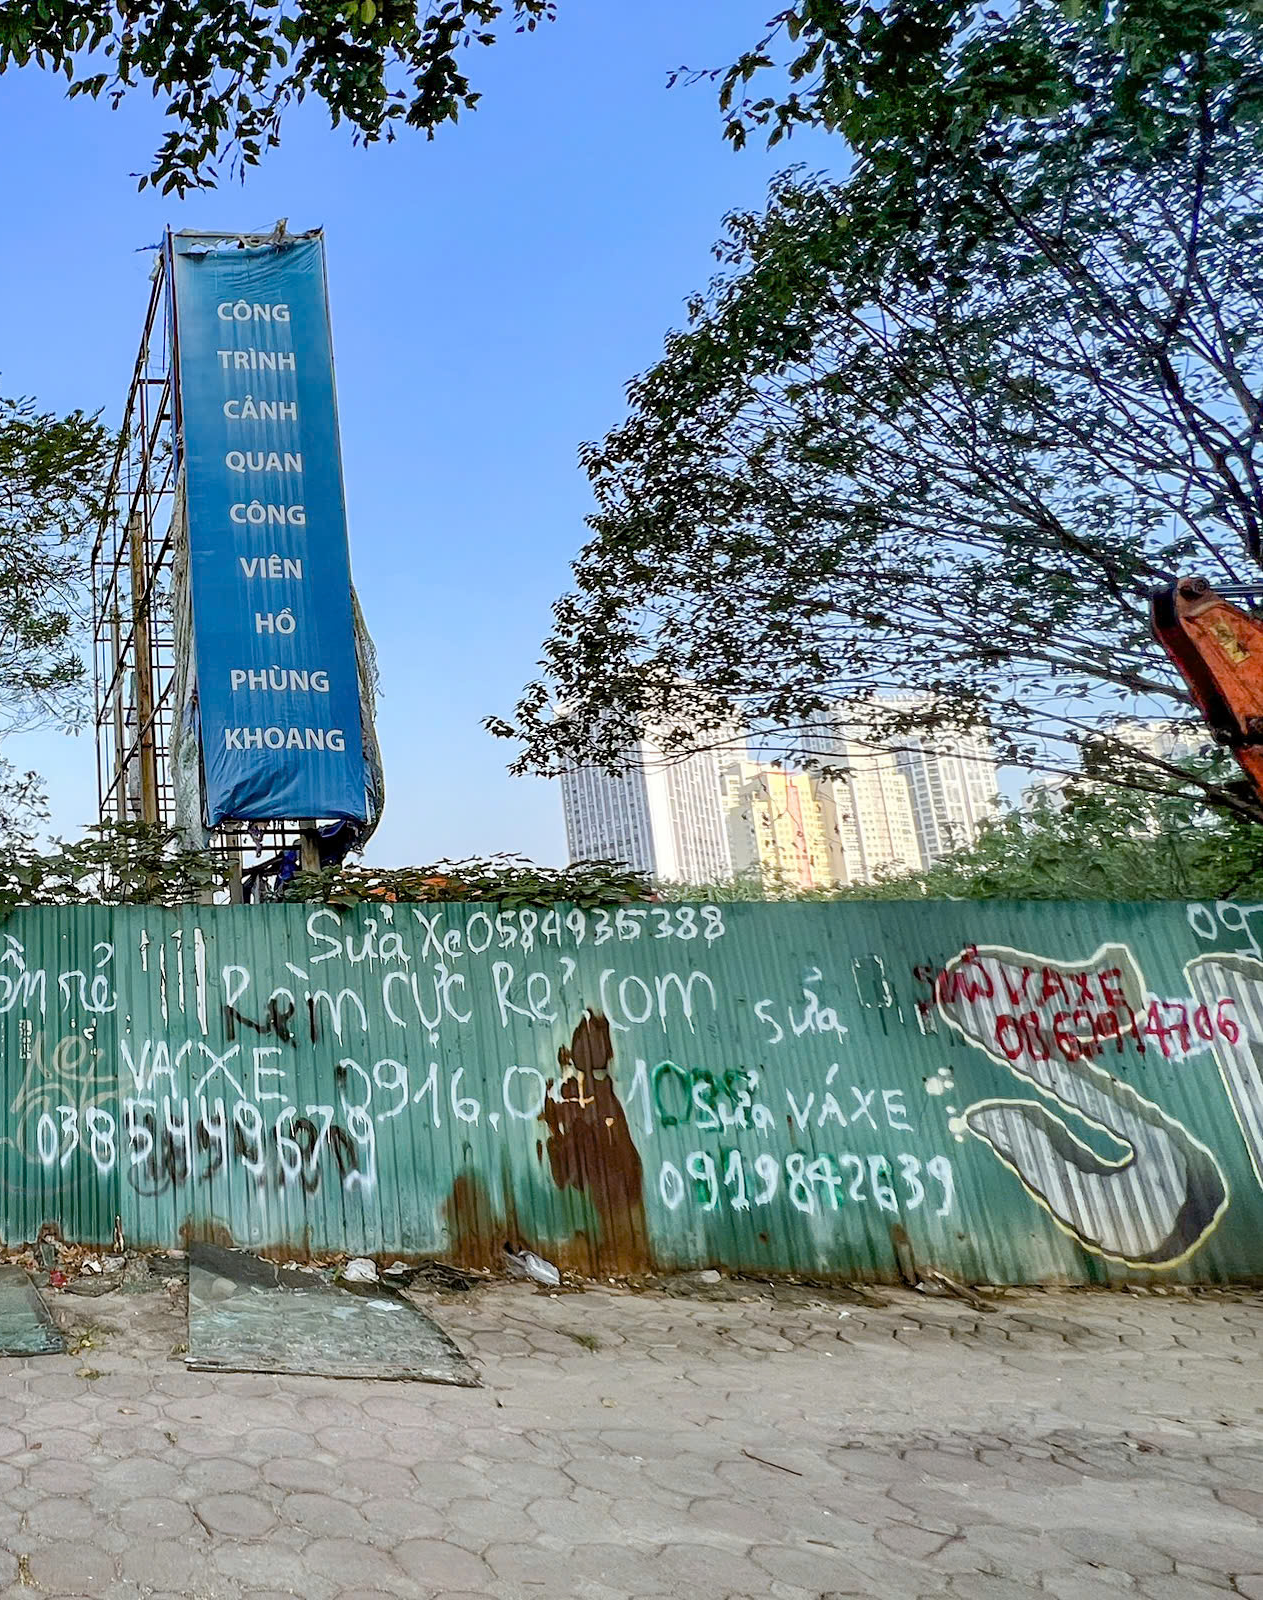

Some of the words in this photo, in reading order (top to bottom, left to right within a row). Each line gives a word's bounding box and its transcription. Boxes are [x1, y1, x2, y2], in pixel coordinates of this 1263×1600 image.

[217, 299, 290, 322] CÔNG
[217, 348, 296, 371] TRÌNH
[223, 394, 298, 420] CẢNH
[225, 451, 303, 473] QUAN
[229, 500, 306, 526] CÔNG
[240, 554, 303, 580] VIÊN
[230, 664, 330, 693] PHÙNG
[224, 727, 346, 752] KHOANG
